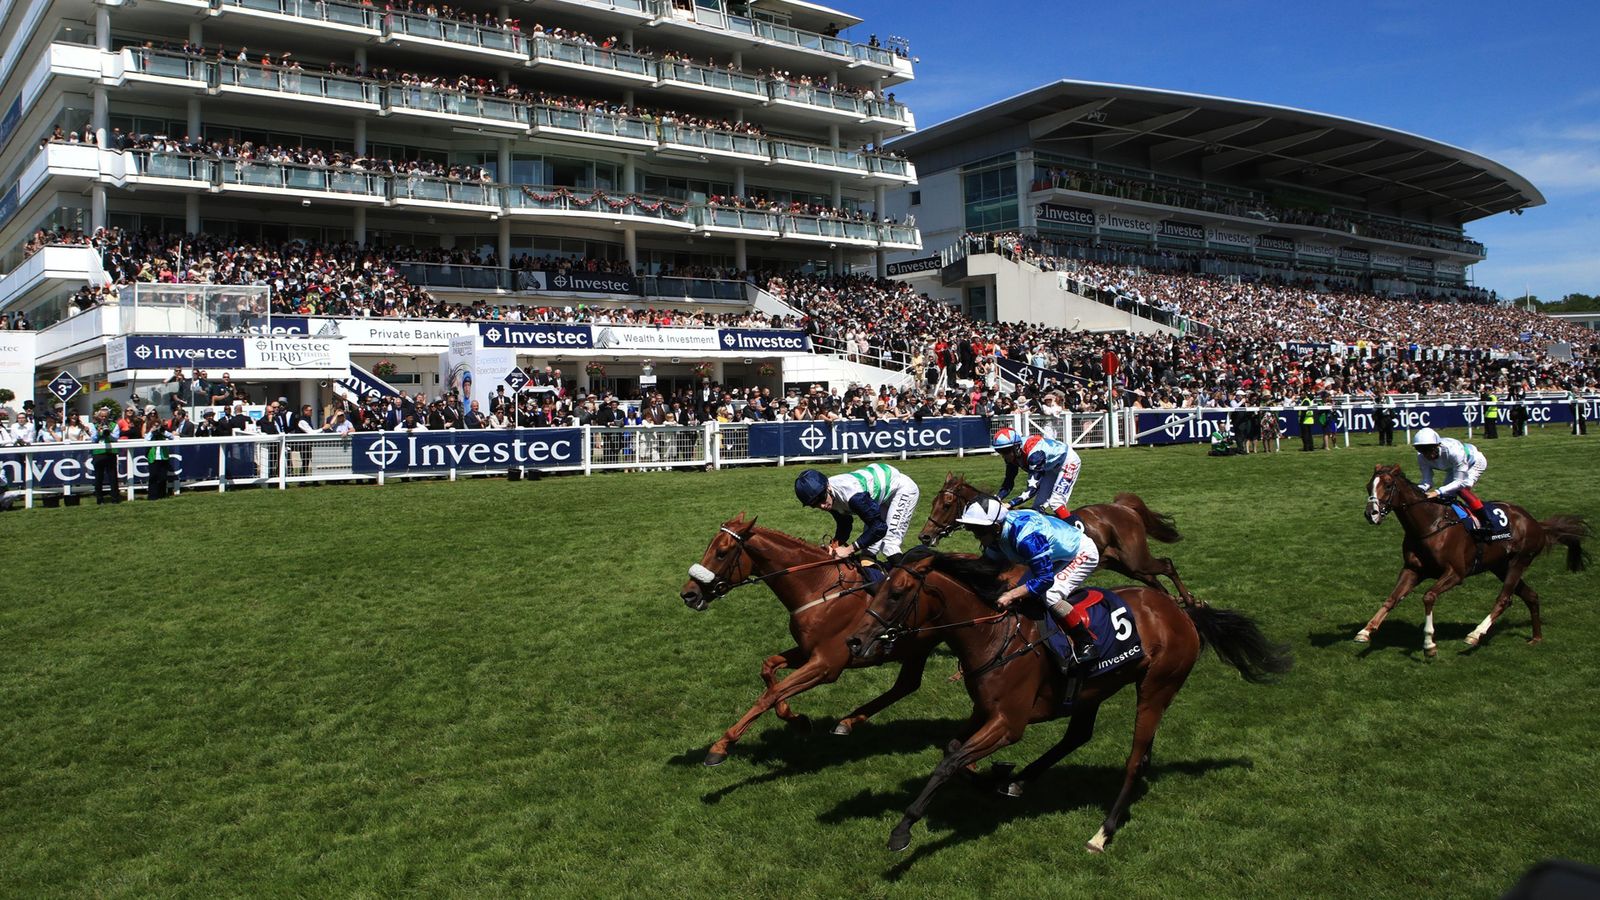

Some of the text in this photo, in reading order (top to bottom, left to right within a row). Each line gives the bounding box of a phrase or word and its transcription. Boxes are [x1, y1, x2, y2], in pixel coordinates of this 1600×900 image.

[1044, 207, 1093, 224] Investec
[1108, 213, 1151, 231] Investec
[1163, 222, 1204, 238] Investec
[1215, 229, 1250, 243] Investec
[897, 260, 941, 273] Investec
[569, 278, 629, 291] Investec
[370, 328, 410, 340] Private
[503, 327, 588, 345] Investec
[623, 333, 714, 345] Wealth & Investment
[737, 333, 802, 349] Investec
[154, 345, 237, 360] Investec
[270, 340, 330, 351] Investec
[261, 352, 303, 362] DERBY
[831, 425, 951, 451] Investec
[408, 436, 571, 467] Investec
[889, 493, 910, 535] ALBASTI
[1492, 508, 1509, 527] 3
[1057, 551, 1089, 581] CITIPOS
[1110, 606, 1133, 641] 5
